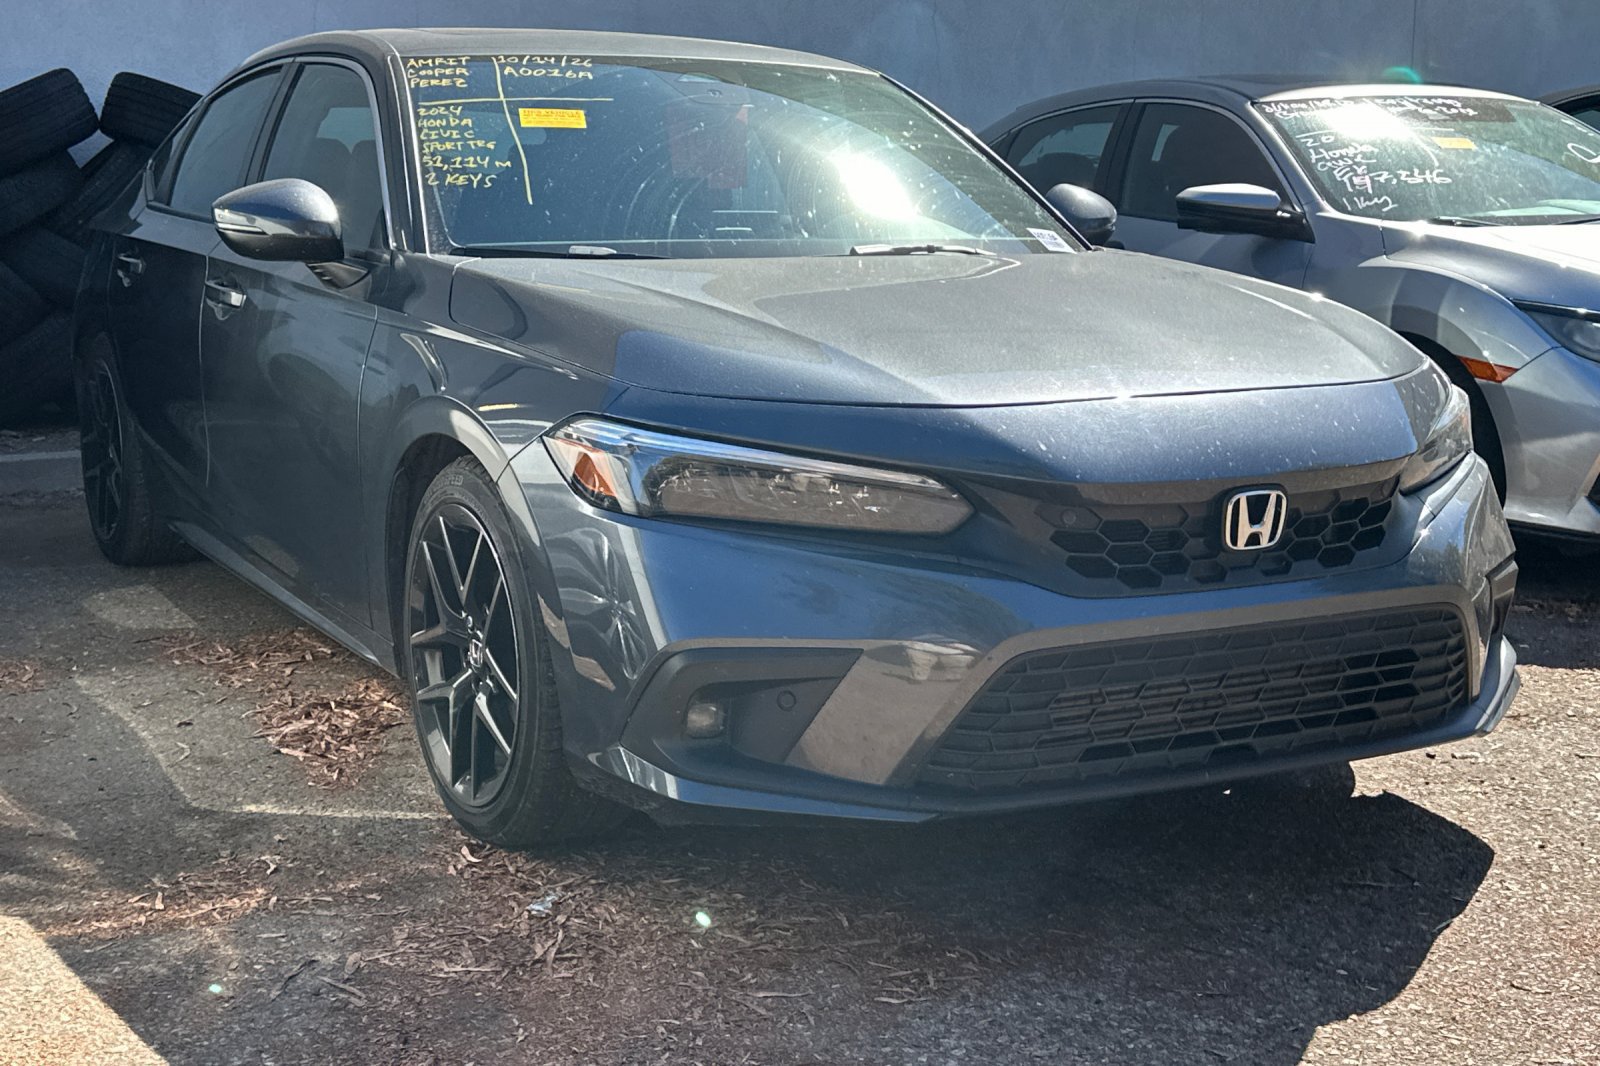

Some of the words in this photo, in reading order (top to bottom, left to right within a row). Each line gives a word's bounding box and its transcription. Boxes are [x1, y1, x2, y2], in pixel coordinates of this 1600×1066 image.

[406, 56, 471, 69] AMRIT
[410, 78, 468, 88] PEREZ
[417, 105, 462, 116] 2024
[418, 116, 472, 128] HONDA
[420, 129, 475, 140] CIVIC
[422, 141, 465, 154] SPORT
[425, 172, 440, 186] 2
[444, 172, 498, 189] KEYS
